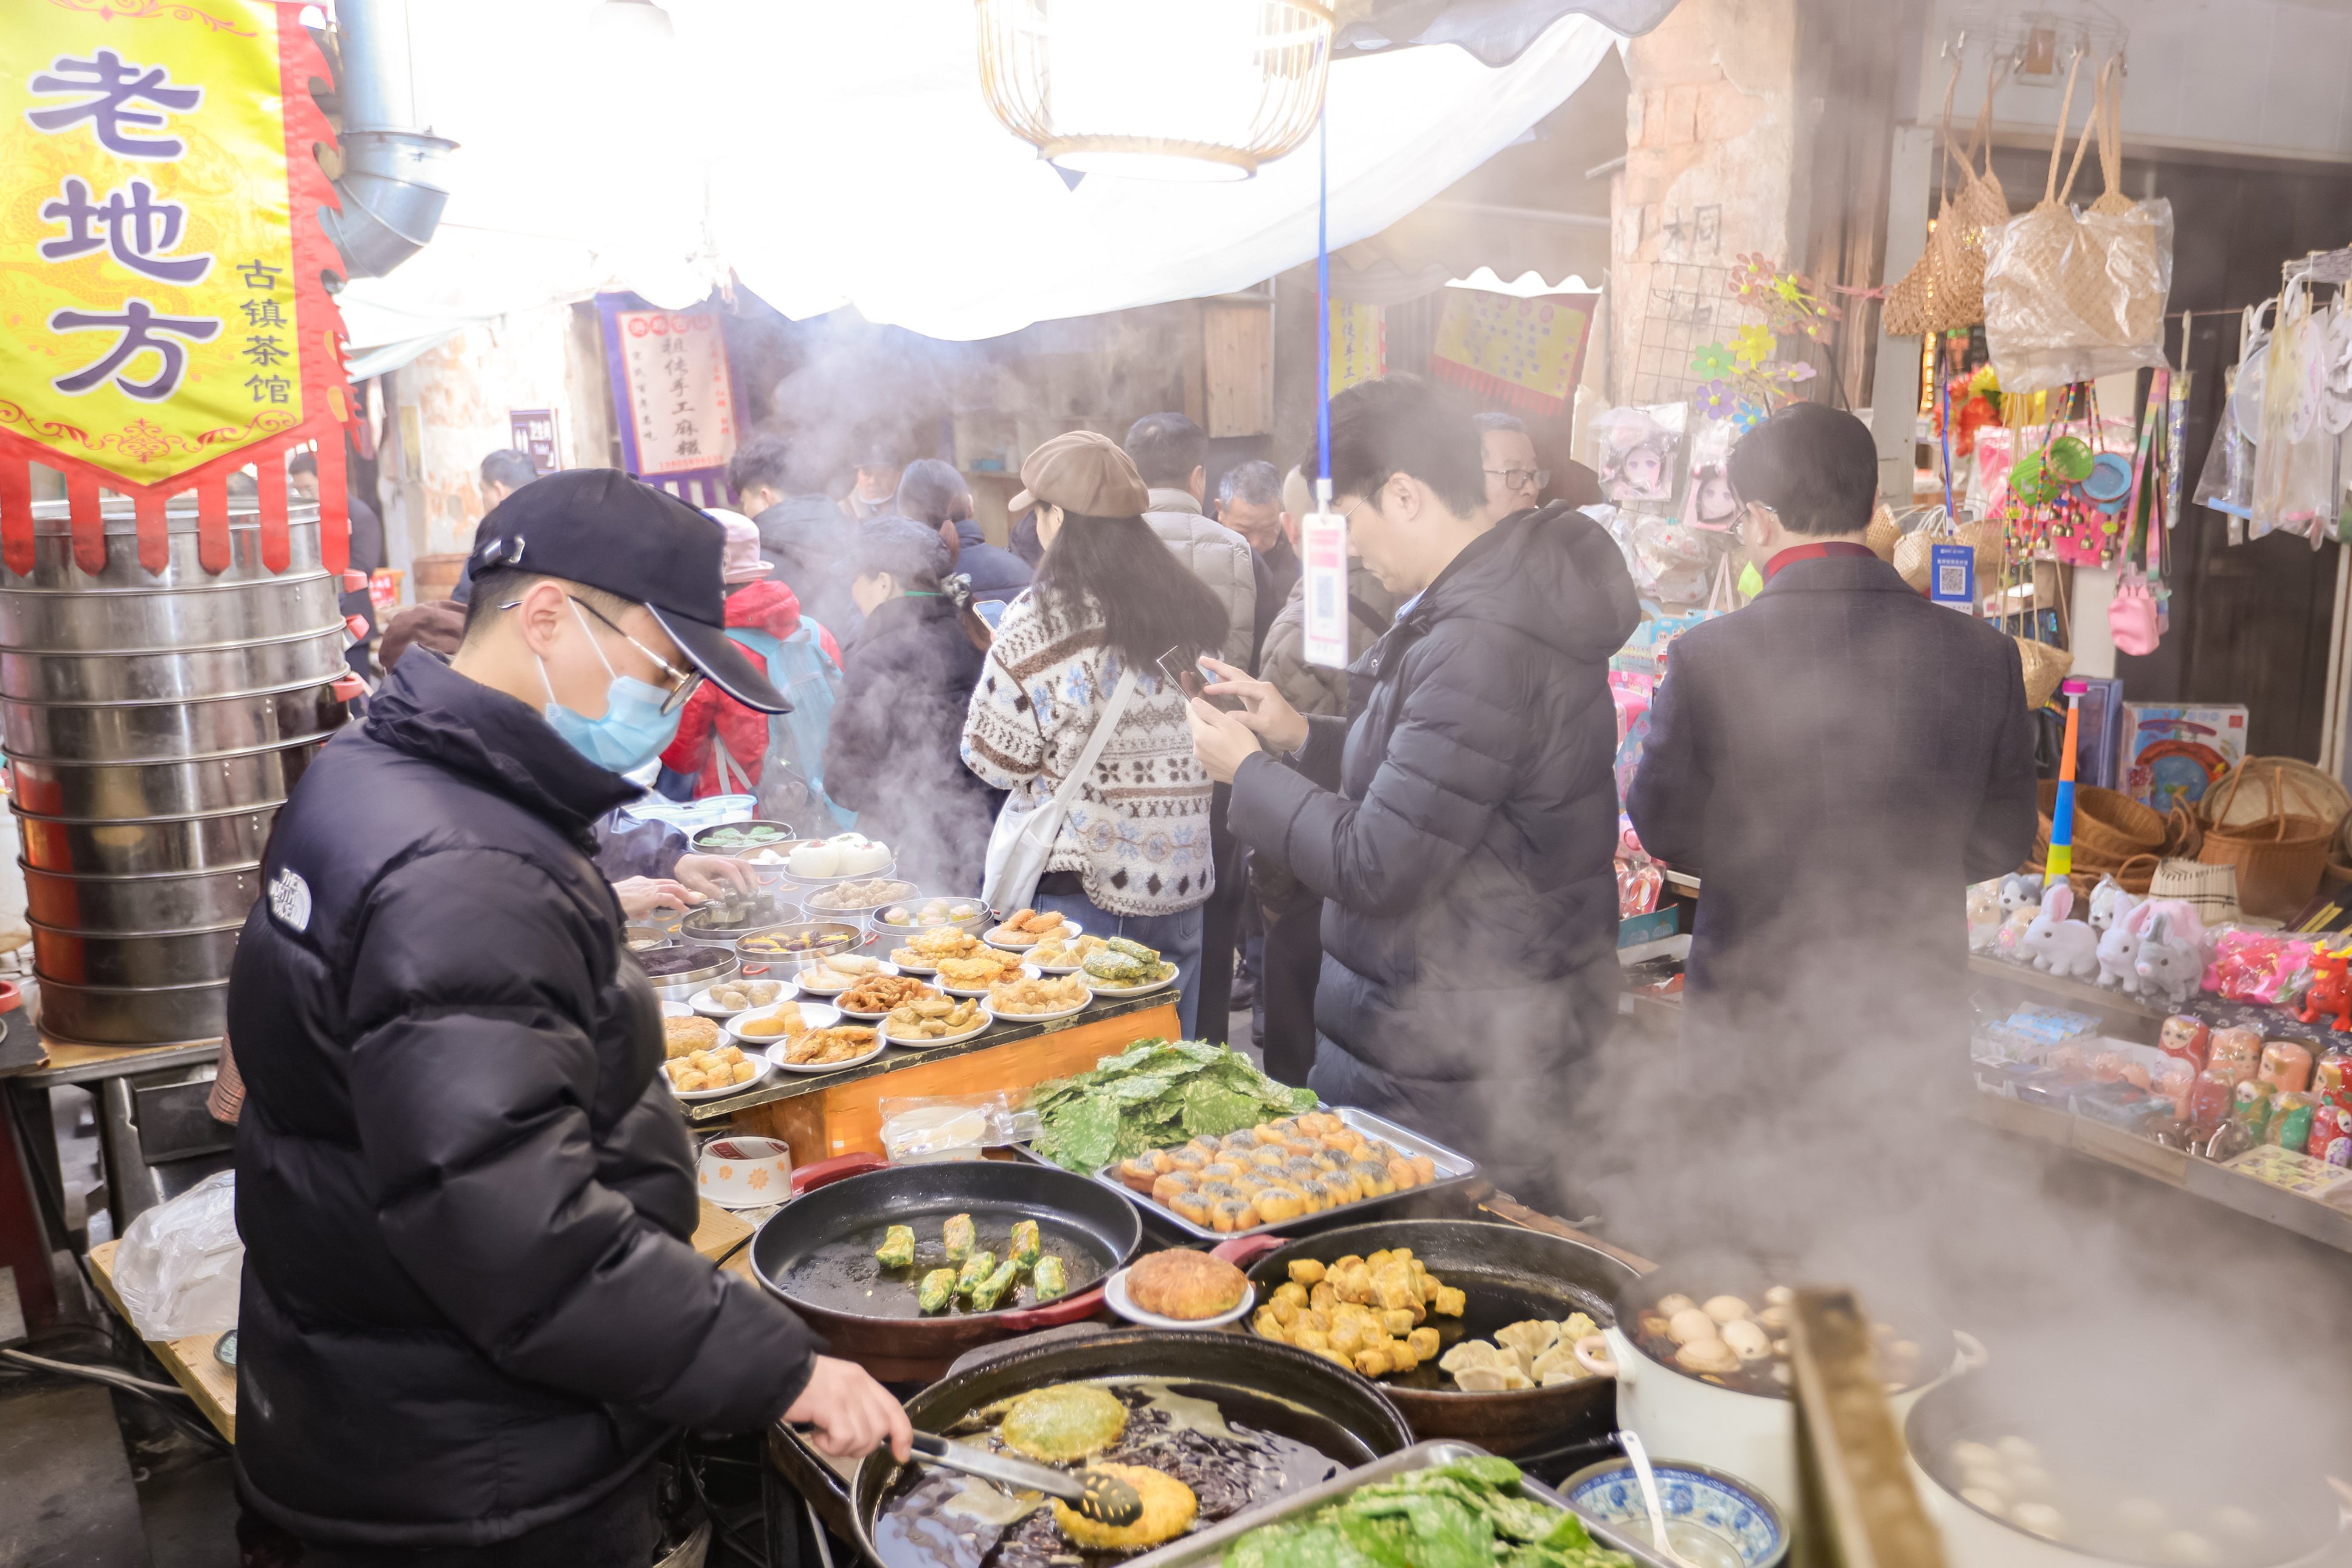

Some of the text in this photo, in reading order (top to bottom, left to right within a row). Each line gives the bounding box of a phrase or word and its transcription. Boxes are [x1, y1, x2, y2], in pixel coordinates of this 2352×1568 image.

[29, 51, 218, 398] 老地方
[237, 258, 291, 404] 古镇茶馆
[1341, 302, 1356, 387] 祖传手工
[271, 879, 296, 905] NORTH
[282, 868, 299, 890] THE
[274, 897, 293, 920] FACE
